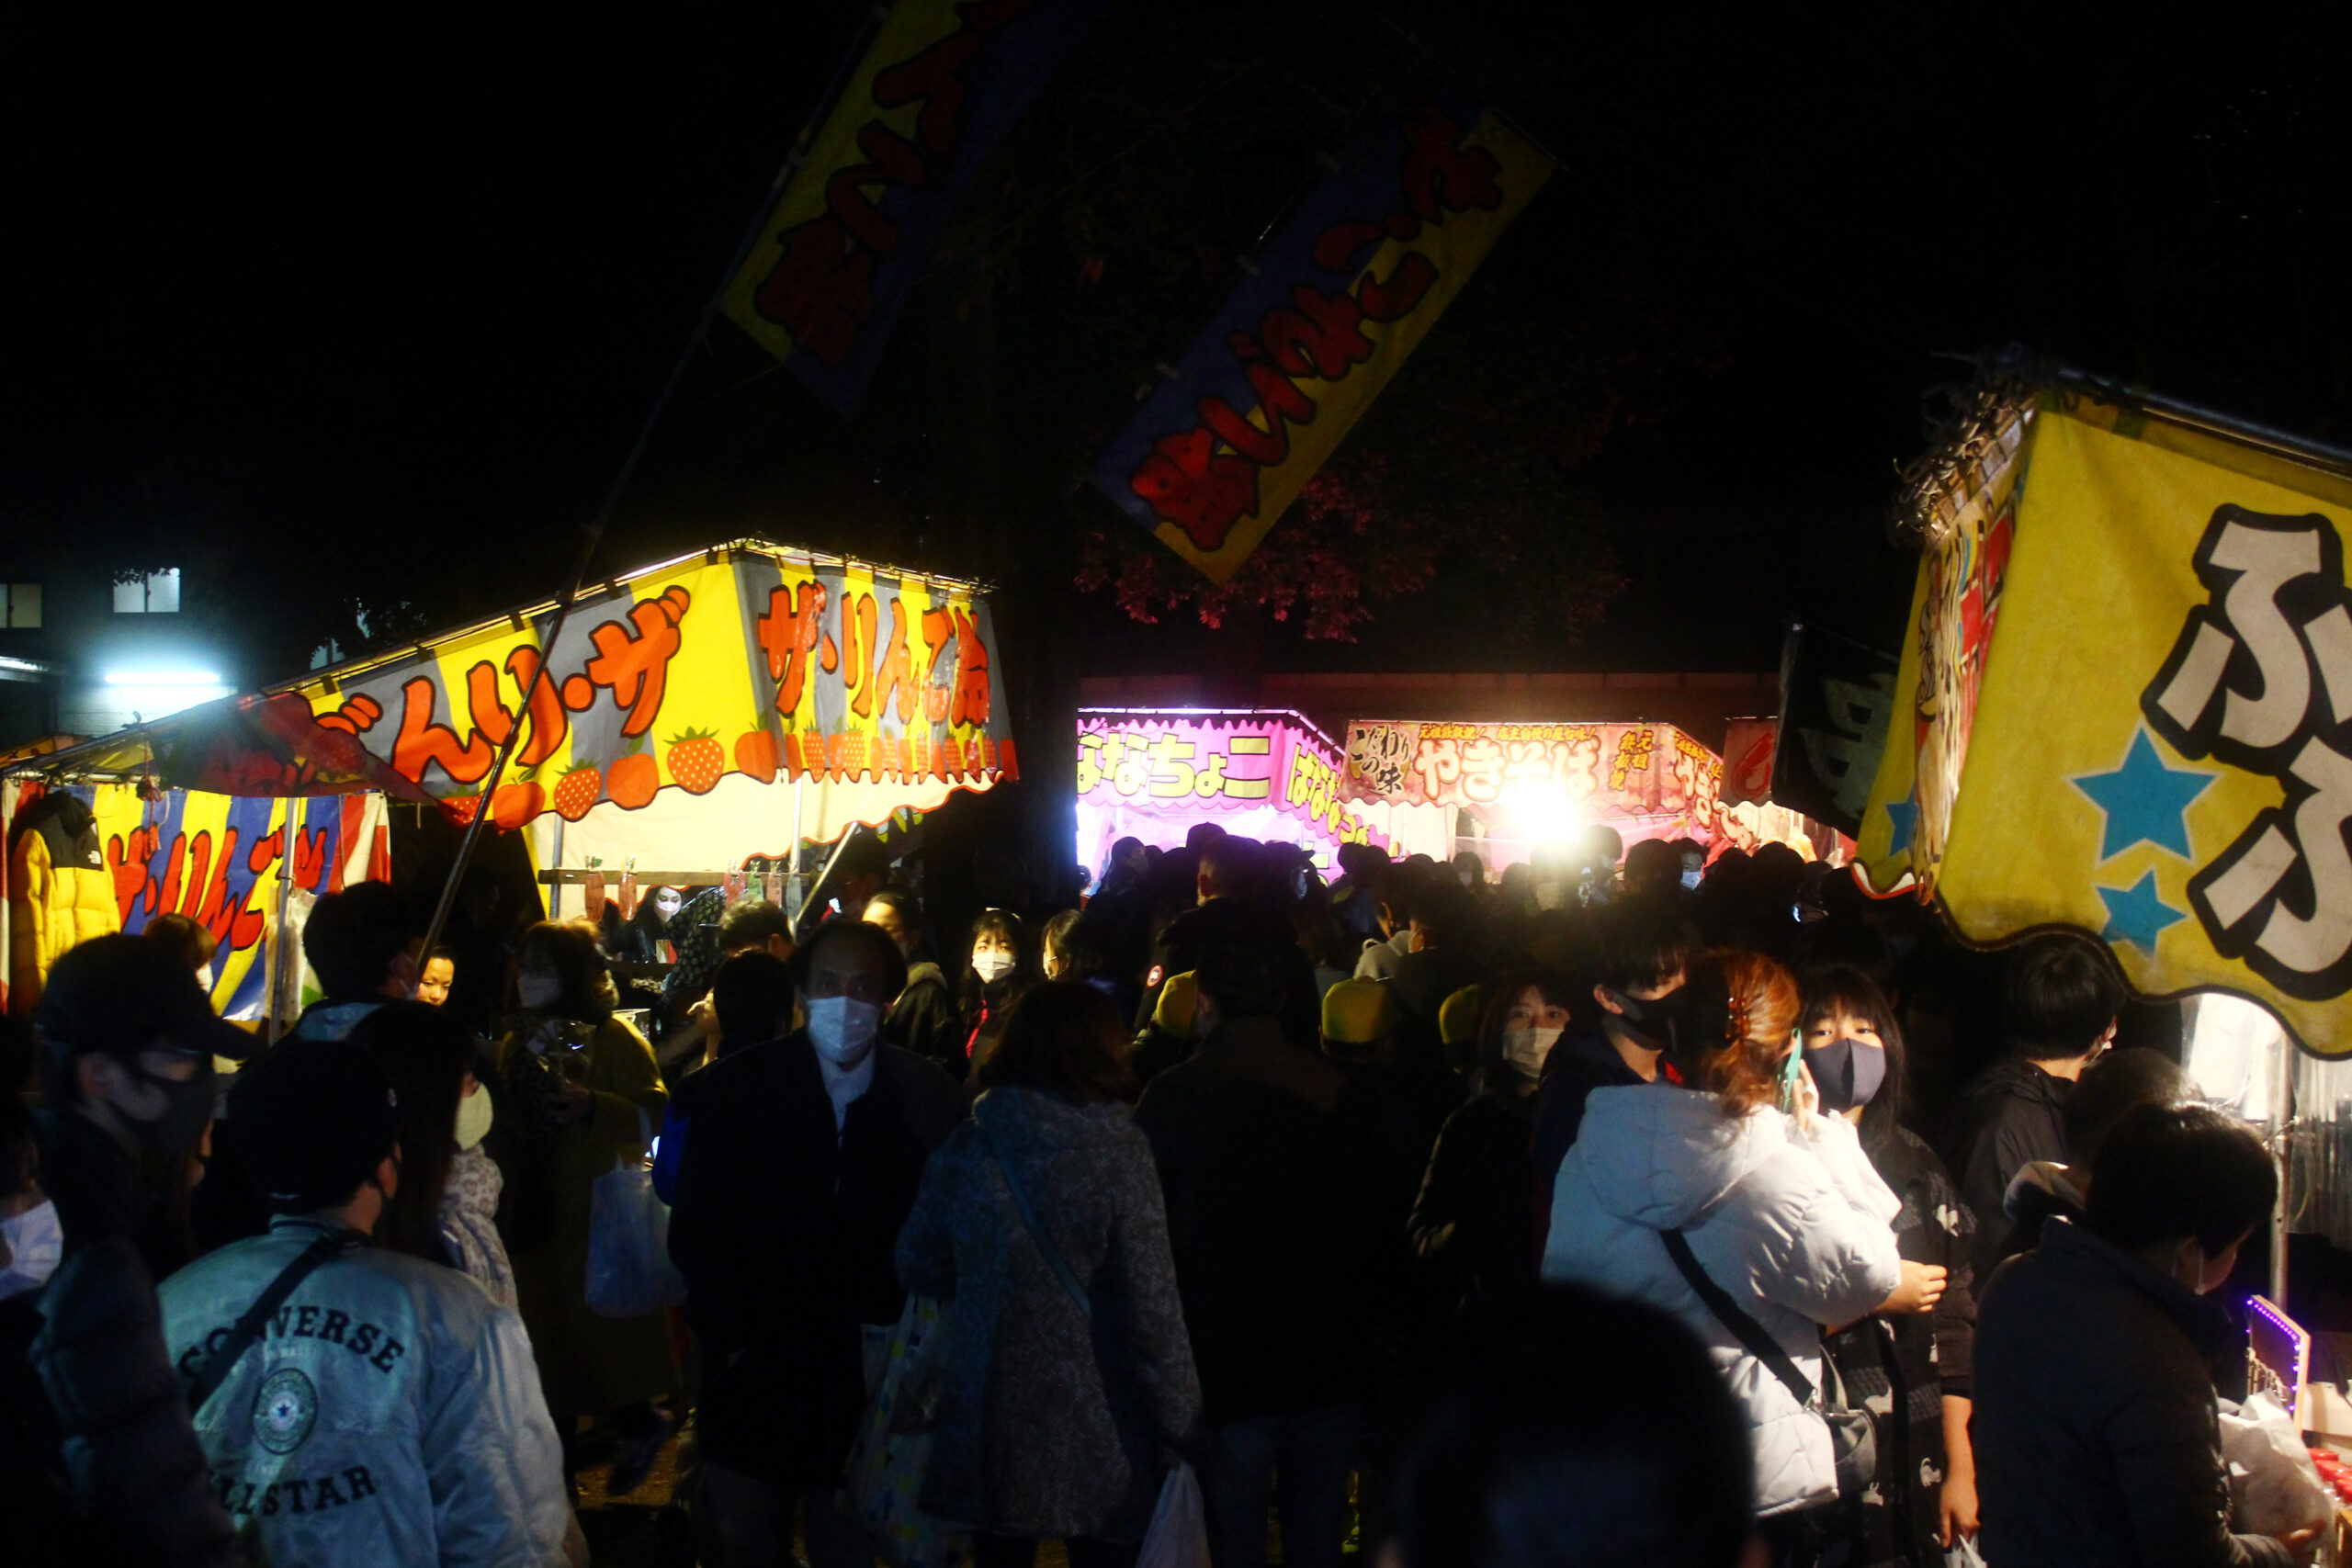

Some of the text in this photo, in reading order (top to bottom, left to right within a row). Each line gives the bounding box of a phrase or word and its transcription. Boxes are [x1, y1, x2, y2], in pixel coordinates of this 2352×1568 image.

[1414, 736, 1601, 802] やきそば
[178, 1305, 405, 1377] COVERSE
